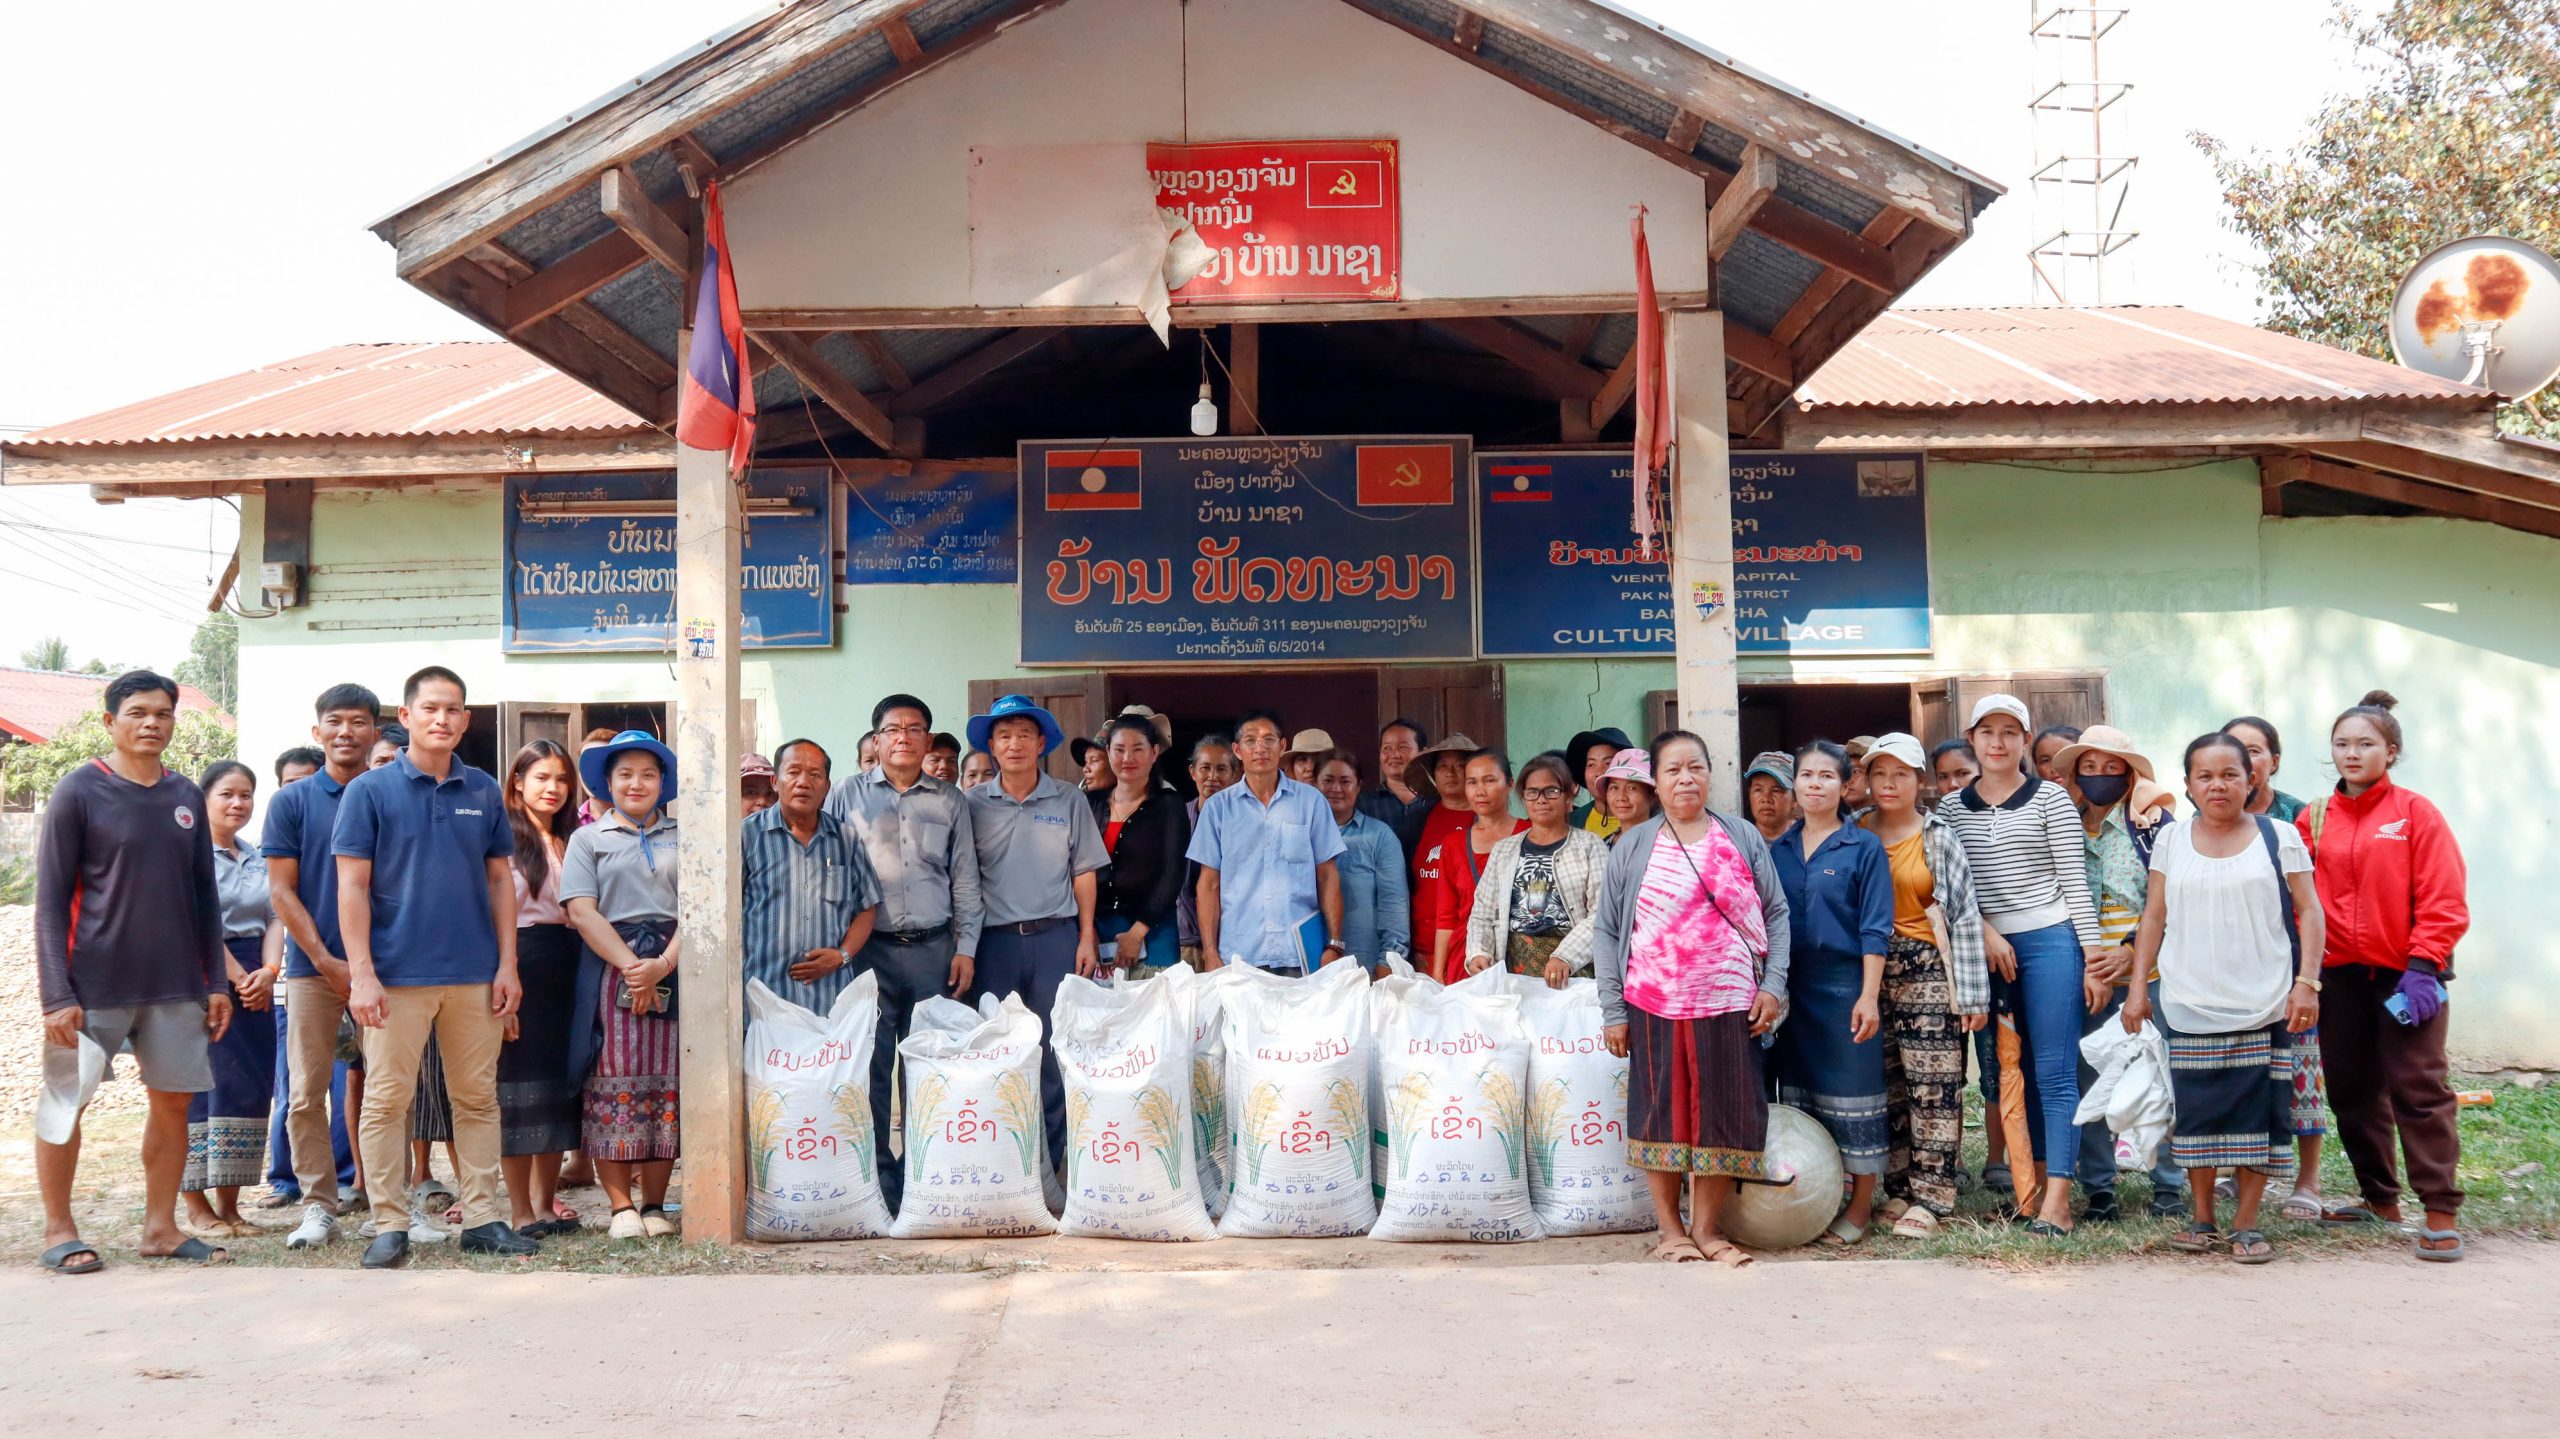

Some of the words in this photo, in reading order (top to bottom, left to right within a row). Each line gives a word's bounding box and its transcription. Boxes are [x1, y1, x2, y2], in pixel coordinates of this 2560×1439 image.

[1307, 245, 1382, 285] ນາຊາ
[1198, 500, 1241, 522] ບ້ານ
[1248, 505, 1304, 525] ນາຊາ
[1046, 535, 1172, 606] ບ້ານ
[1192, 535, 1456, 605] ພັດທະນາ
[1734, 572, 1800, 582] APITAL
[1621, 591, 1654, 601] PAK
[1126, 620, 1143, 633] 25
[1262, 618, 1286, 631] 311
[1553, 628, 1676, 644] CULTUR
[1735, 625, 1864, 642] VILLAGE
[1268, 640, 1326, 653] 6/5/2014
[986, 1224, 1039, 1237] KOPIA
[1470, 1228, 1523, 1242] KOPIA
